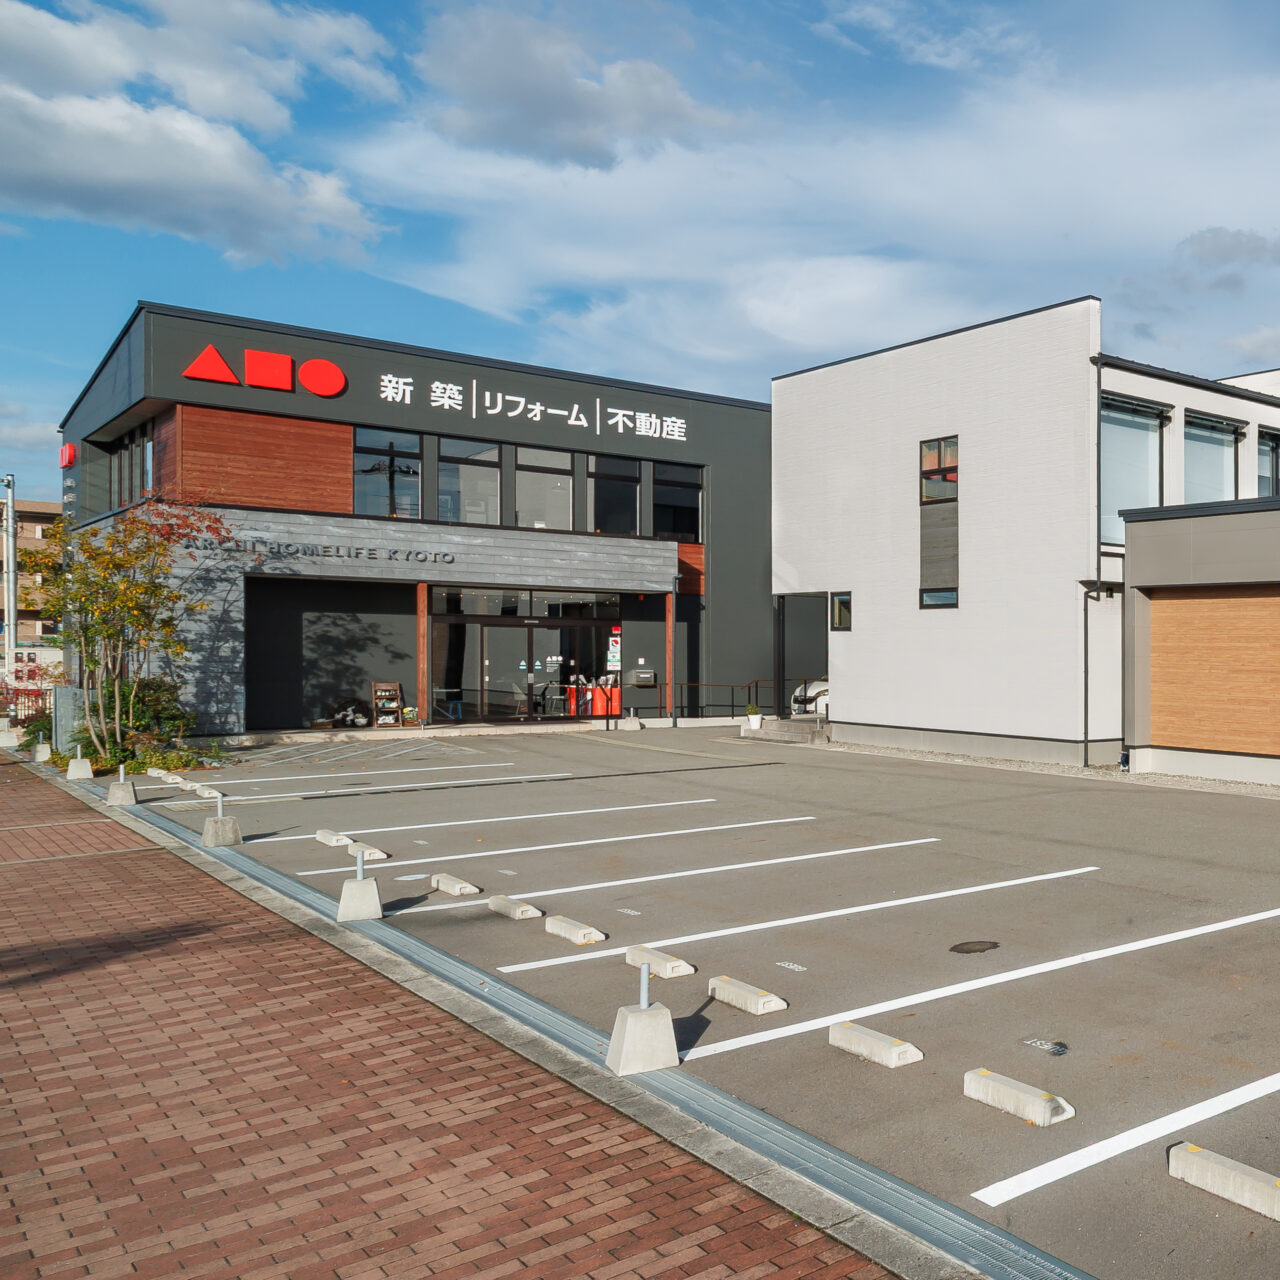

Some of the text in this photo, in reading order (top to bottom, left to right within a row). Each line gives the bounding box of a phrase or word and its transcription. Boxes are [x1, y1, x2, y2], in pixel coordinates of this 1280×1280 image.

[484, 391, 589, 427] リフォーム
[607, 407, 686, 441] 不動産
[267, 541, 377, 560] HOMELIFE
[388, 549, 455, 564] KYOTO
